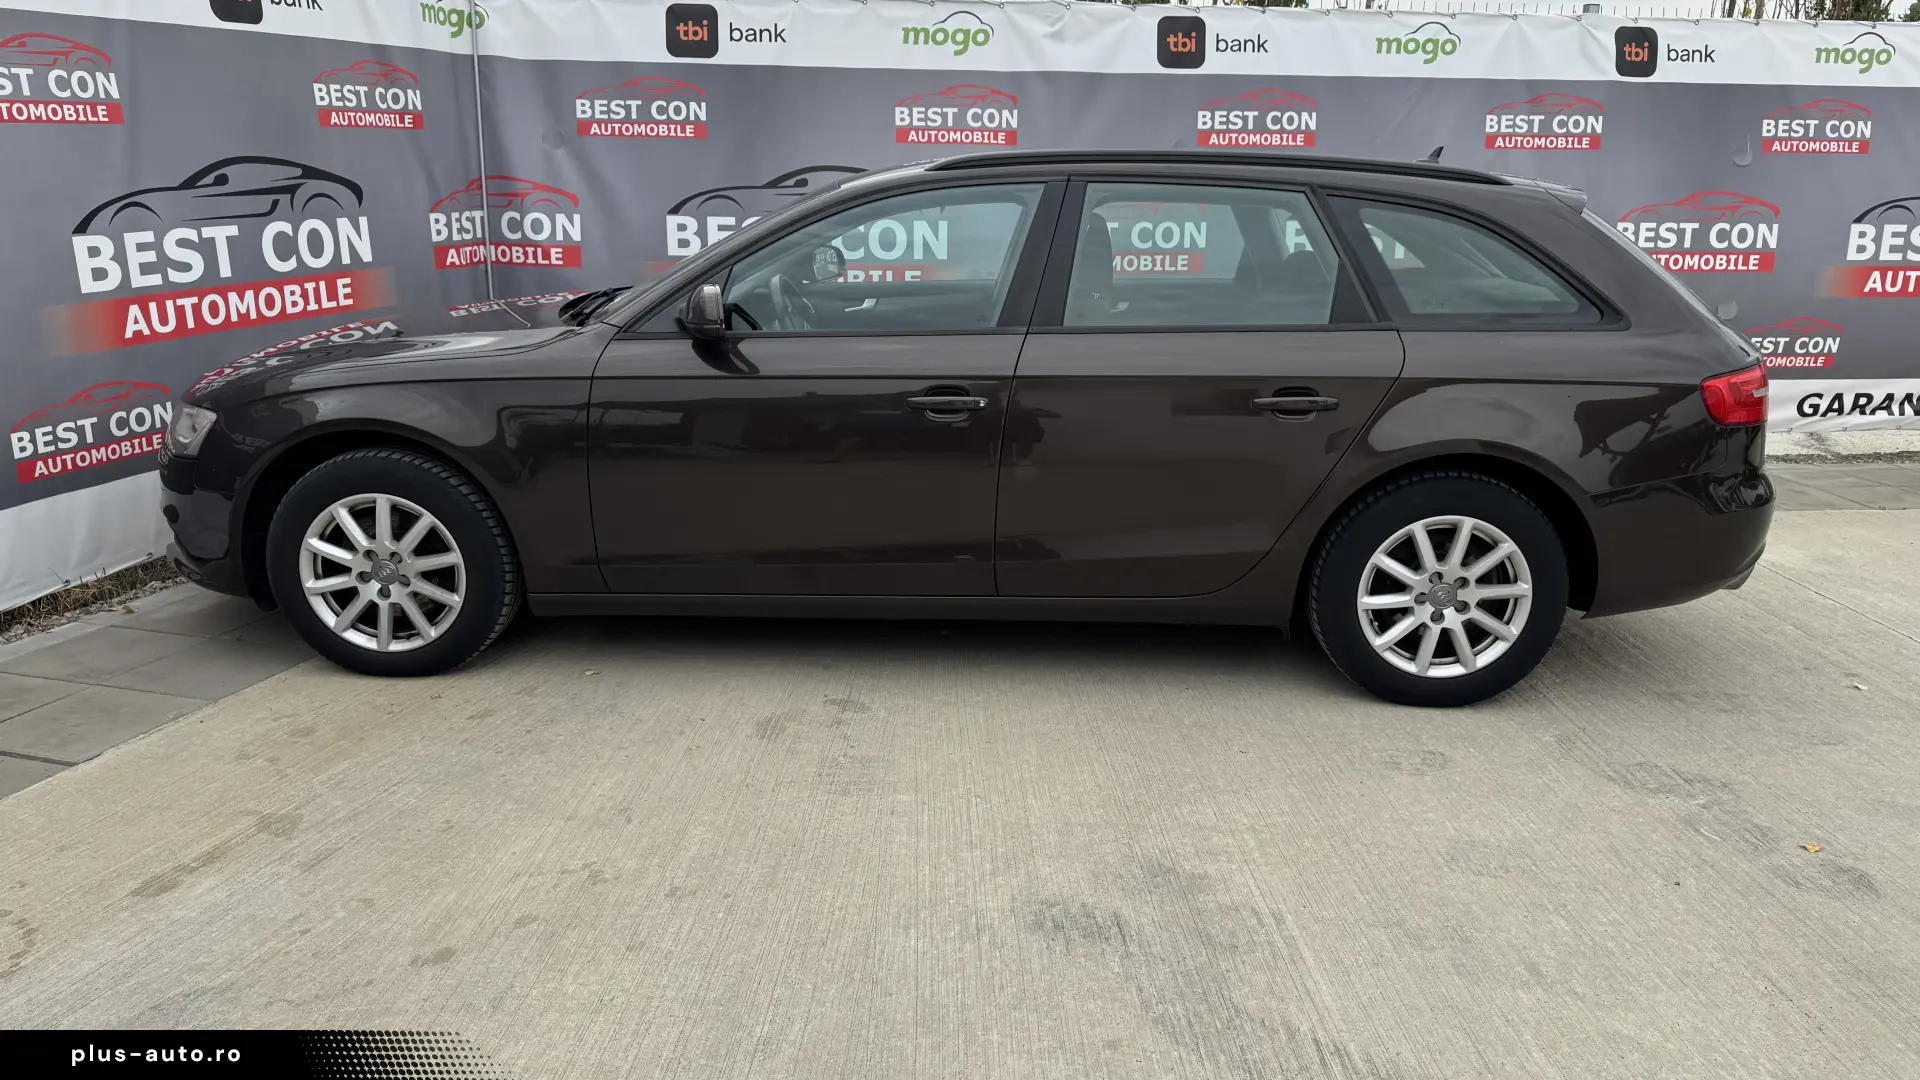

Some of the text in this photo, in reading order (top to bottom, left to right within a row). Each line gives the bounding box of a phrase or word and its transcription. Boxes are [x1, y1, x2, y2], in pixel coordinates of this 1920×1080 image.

[420, 2, 486, 38] mogo
[676, 20, 787, 43] tbi bank
[902, 24, 991, 57] mogo
[1167, 32, 1269, 54] tbi bank
[1376, 37, 1459, 65] mogo
[1624, 42, 1715, 64] tbi bank
[1815, 46, 1892, 74] mogo
[47, 69, 120, 99] CON
[313, 82, 422, 111] BEST CON
[330, 112, 413, 128] AUTOMOBILE
[575, 99, 707, 122] BEST CON
[895, 107, 1018, 129] BEST CON
[1197, 110, 1317, 131] BEST CON
[590, 123, 695, 137] AUTOMOBILE
[1485, 114, 1603, 134] BEST CON
[1761, 119, 1872, 139] BEST CON
[908, 130, 1006, 144] AUTOMOBILE
[1208, 133, 1305, 146] AUTOMOBILE
[1495, 136, 1590, 149] AUTOMOBILE
[1771, 140, 1860, 153] AUTOMOBILE
[429, 210, 582, 242] BEST CON
[1131, 221, 1208, 249] CON
[1709, 222, 1779, 249] CON
[666, 215, 948, 260] BE CON
[72, 216, 373, 294] BEST CON
[446, 245, 563, 266] AUTOMOBILE
[1652, 254, 1760, 271] TOMOBILE
[124, 278, 353, 339] AUTOMOBILE
[1794, 337, 1841, 354] CON
[1763, 356, 1825, 367] OMOBILE
[10, 401, 174, 460] BEST CON
[34, 434, 162, 478] AUTOMOBILE
